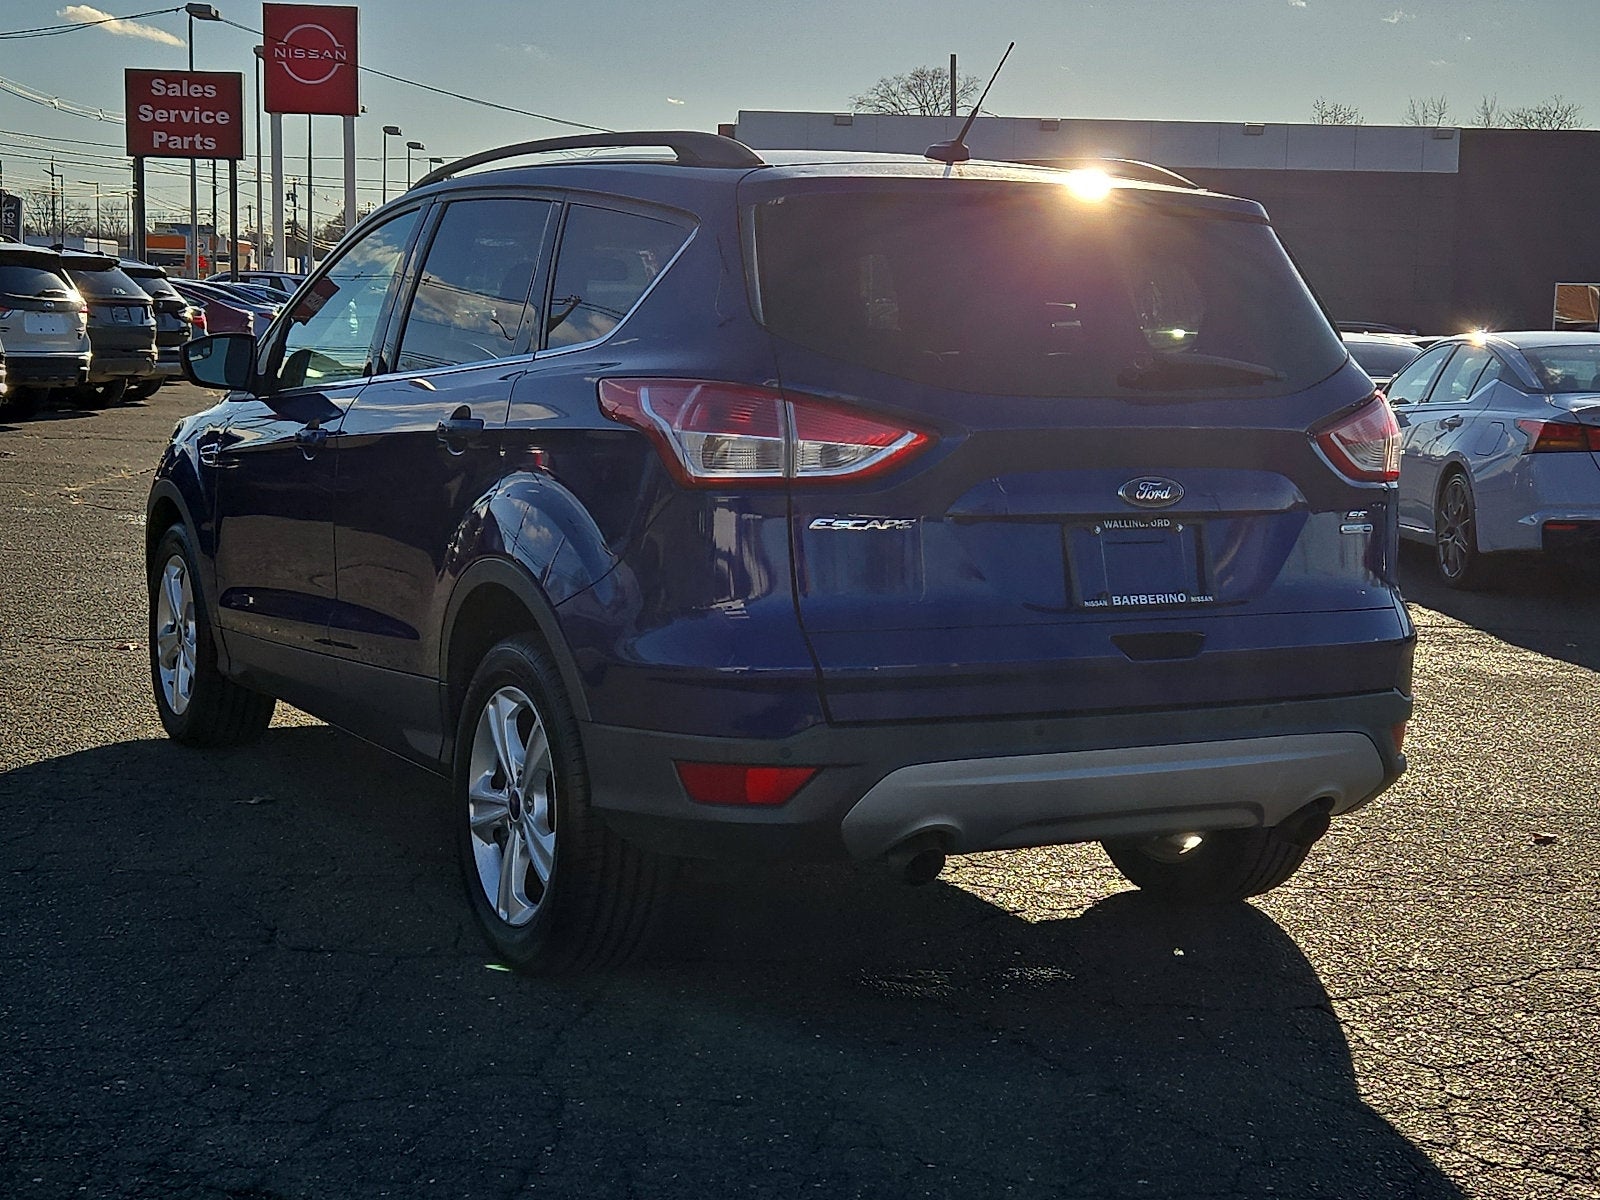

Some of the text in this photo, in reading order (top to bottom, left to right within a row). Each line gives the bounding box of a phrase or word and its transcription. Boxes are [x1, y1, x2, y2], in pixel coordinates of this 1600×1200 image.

[274, 47, 347, 60] NISSAN
[151, 78, 217, 98] Sales
[138, 104, 230, 125] Service
[152, 131, 217, 151] Parts
[1135, 481, 1171, 500] Ford
[808, 518, 917, 530] ESCAPE
[1084, 592, 1214, 607] NISSAN BARBERINO NISSAN
